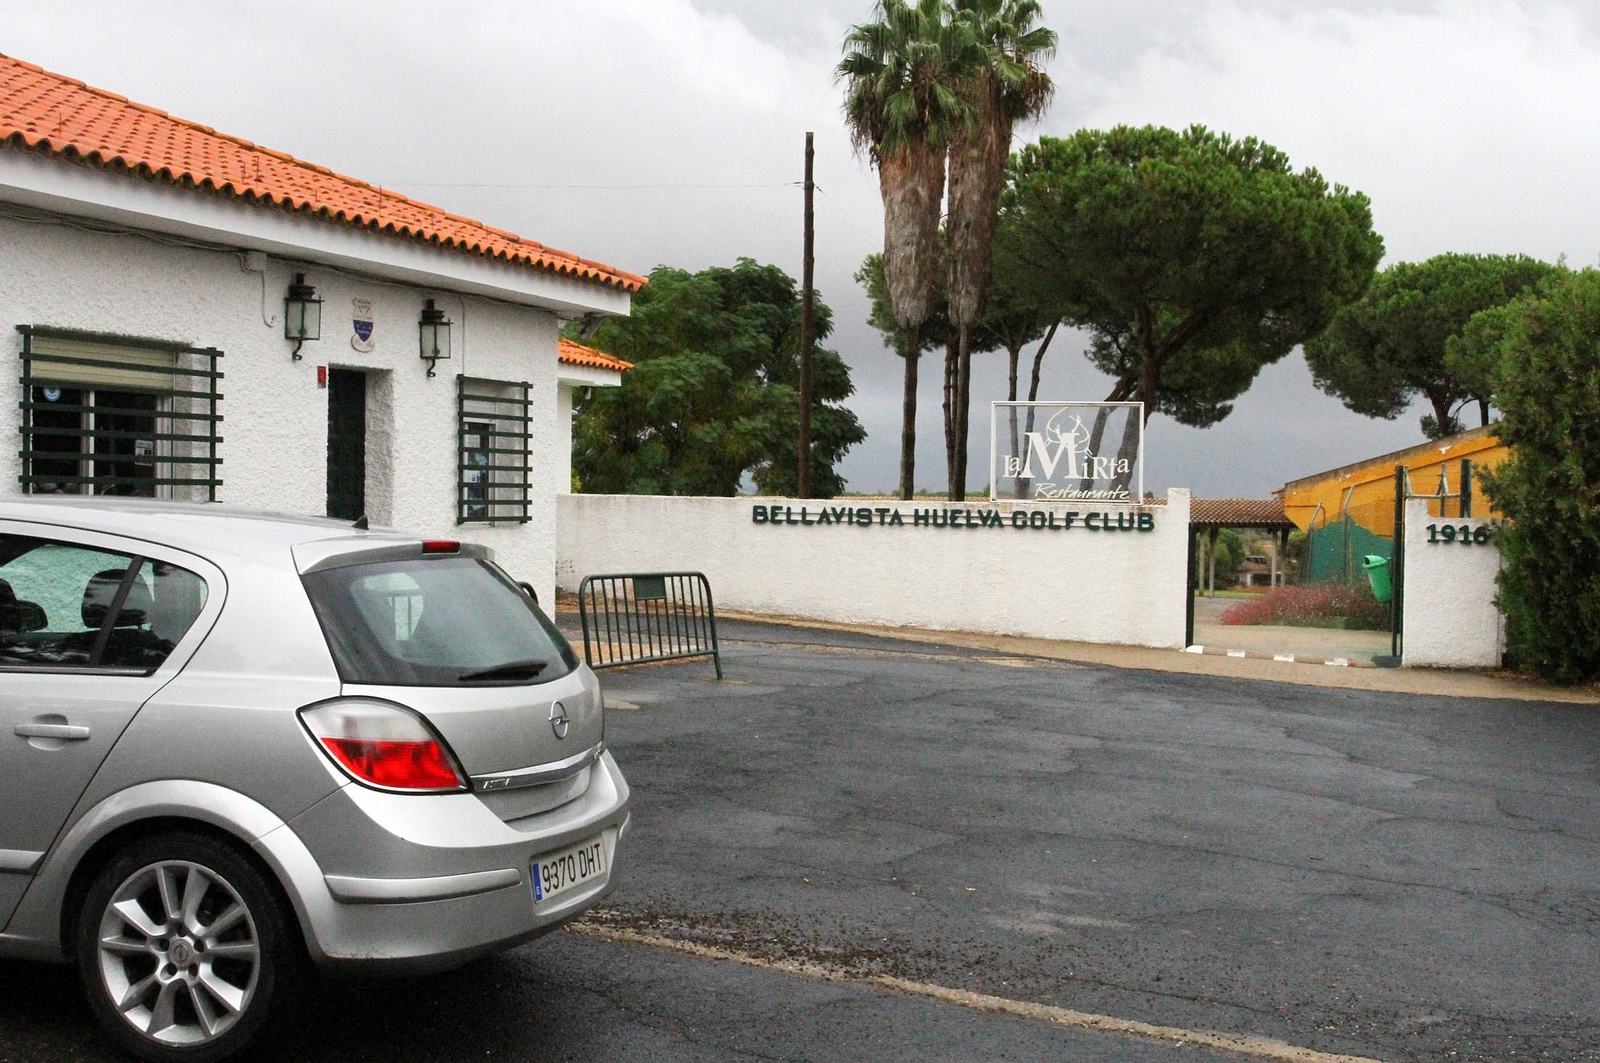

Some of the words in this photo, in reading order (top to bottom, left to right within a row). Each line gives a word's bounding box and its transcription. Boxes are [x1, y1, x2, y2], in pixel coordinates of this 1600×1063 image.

[1034, 482, 1130, 500] Restaurante
[752, 505, 904, 527] BELLAVISTA
[913, 508, 1004, 529] HUELVA
[1012, 510, 1079, 530] GOLF
[1085, 512, 1155, 532] CLUB
[1426, 523, 1488, 545] 1916
[542, 854, 576, 893] 9370
[578, 843, 601, 878] DHT
